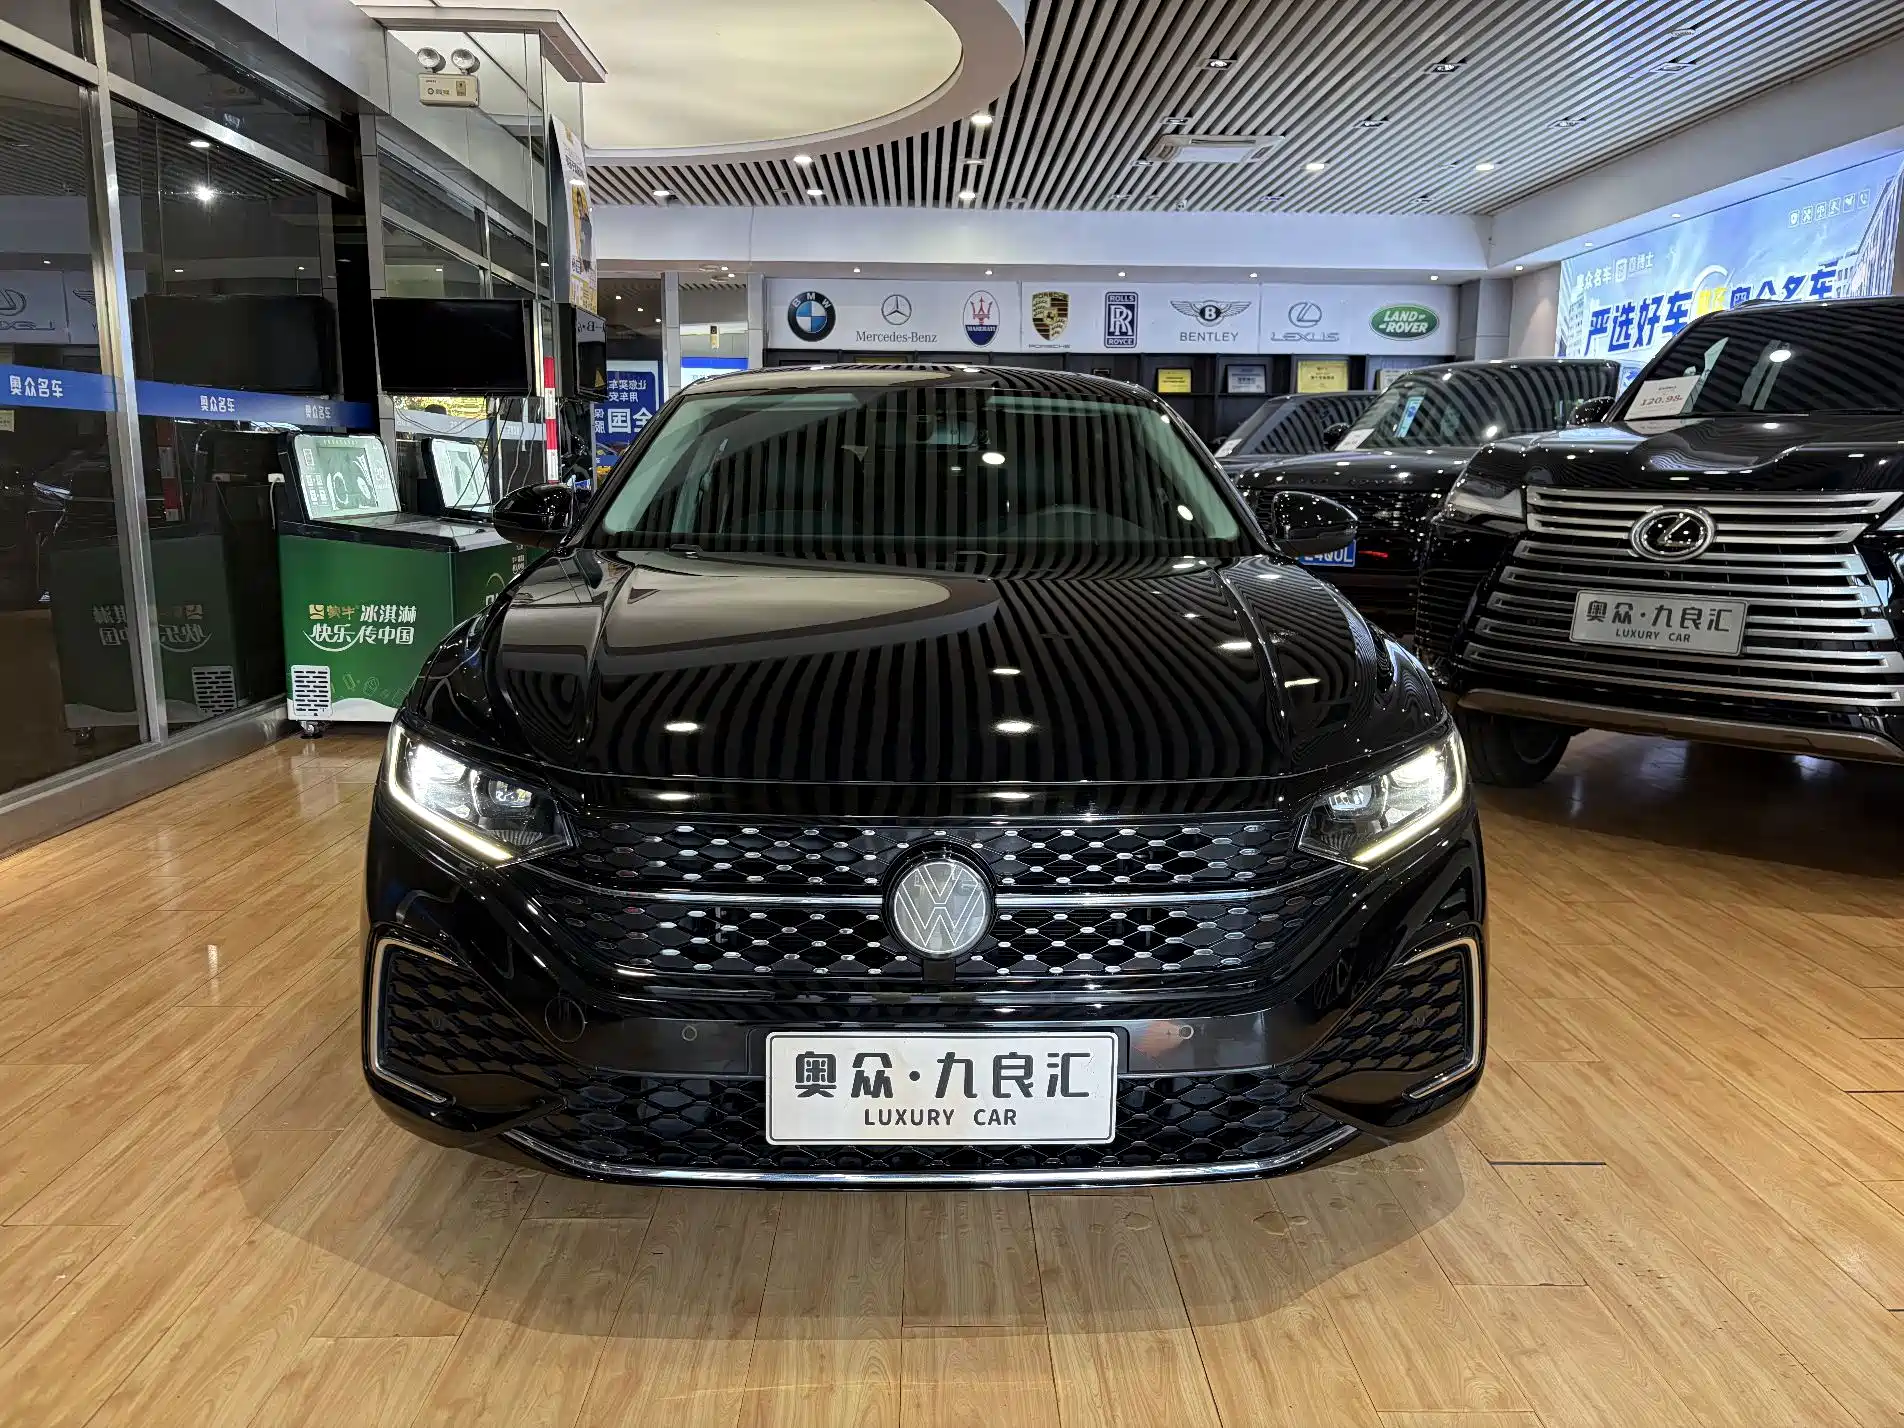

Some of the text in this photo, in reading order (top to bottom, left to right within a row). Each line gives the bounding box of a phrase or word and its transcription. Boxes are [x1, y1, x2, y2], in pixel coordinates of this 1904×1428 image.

[792, 292, 831, 309] BMW
[1384, 310, 1420, 322] LAND
[1584, 290, 1693, 355] 严选好车
[1387, 321, 1429, 333] ROVER
[855, 330, 938, 343] Mercedes-Benz
[1179, 332, 1238, 342] BENTLEY
[1270, 332, 1340, 342] LEXUS
[9, 375, 63, 398] 奥众名车
[200, 395, 235, 413] 奥众名车
[305, 404, 331, 419] 奥众名车
[360, 604, 417, 623] 冰淇淋
[1587, 600, 1732, 633] 奥众·九良汇
[1616, 628, 1691, 643] LUXURY CAR
[795, 1051, 1091, 1099] 奥众·九良汇
[864, 1108, 1017, 1126] LUXURY CAR
